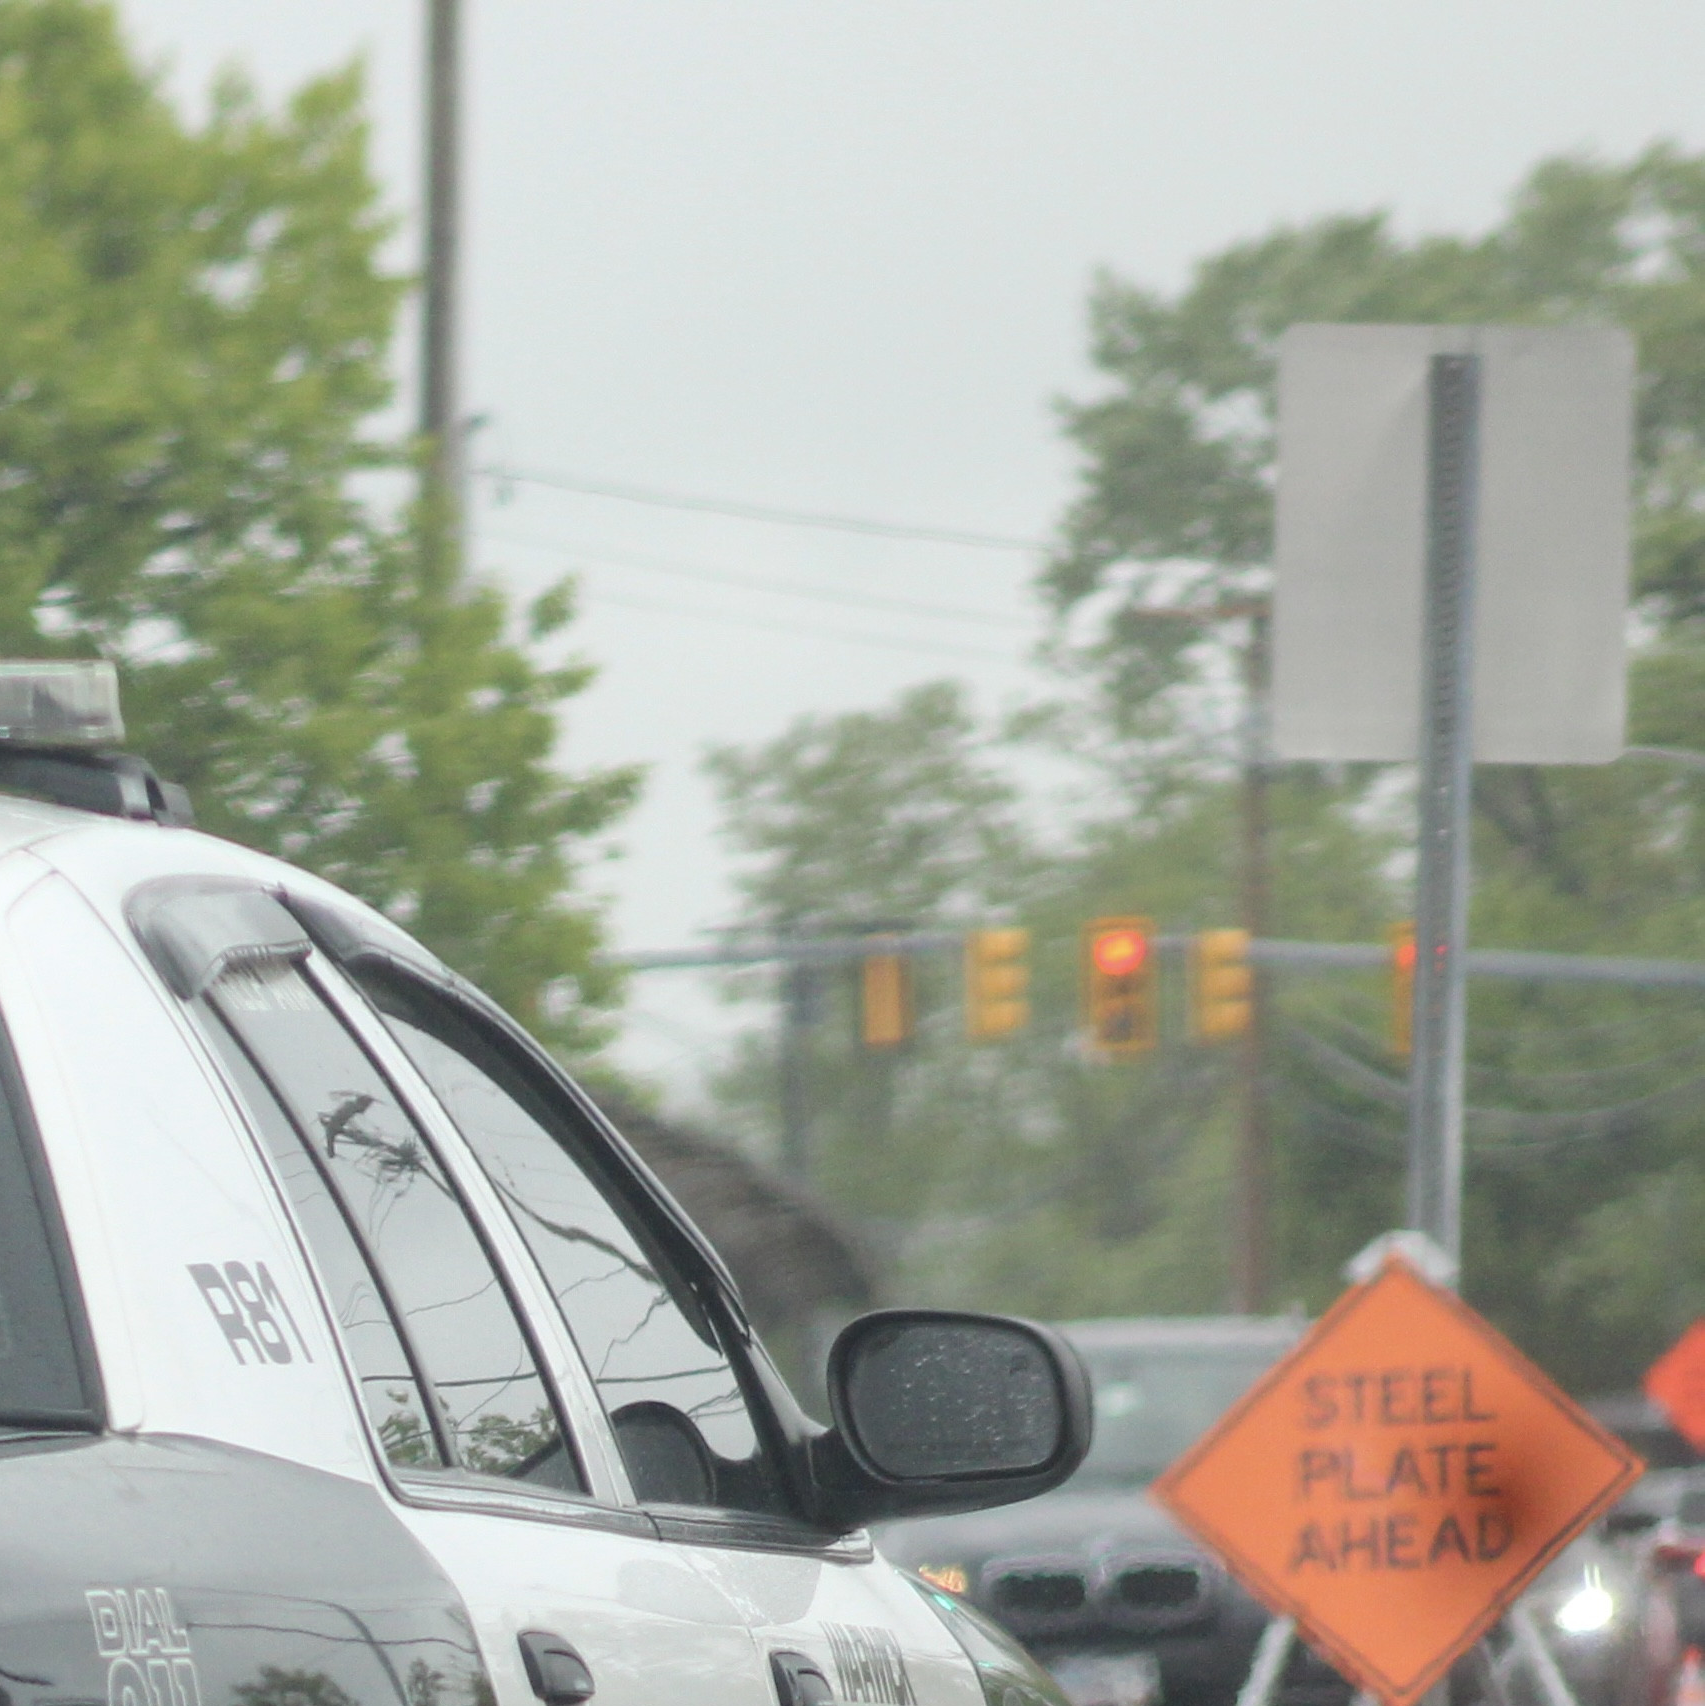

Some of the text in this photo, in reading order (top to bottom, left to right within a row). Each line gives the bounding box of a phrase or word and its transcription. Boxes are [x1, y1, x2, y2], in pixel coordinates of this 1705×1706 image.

[185, 1260, 314, 1365] R81
[1300, 1368, 1497, 1430] STEEL
[1298, 1441, 1501, 1500] PLATE
[1290, 1515, 1515, 1573] AHEAD
[85, 1586, 192, 1656] DIAL
